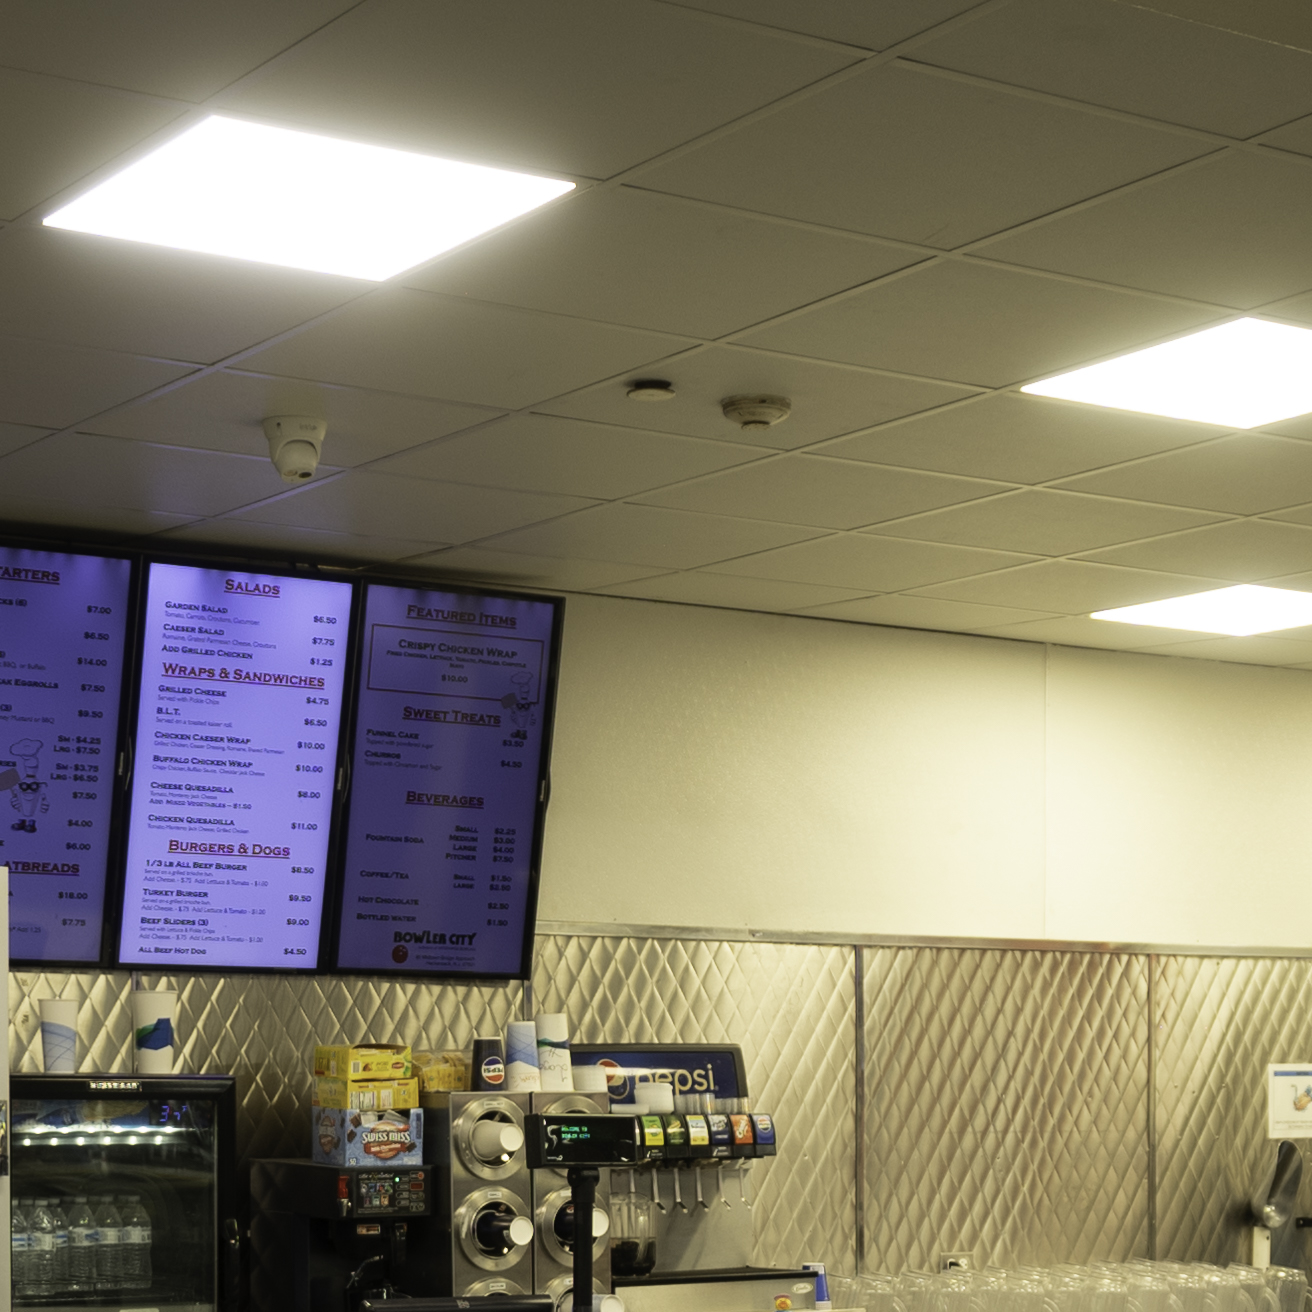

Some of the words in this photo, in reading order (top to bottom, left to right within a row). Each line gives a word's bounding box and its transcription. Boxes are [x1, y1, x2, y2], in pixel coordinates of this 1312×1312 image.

[225, 578, 280, 595] SALADS
[407, 604, 476, 622] FEATURED
[479, 612, 516, 626] ITEMS
[162, 662, 215, 678] WRAPS
[219, 667, 230, 680] &
[233, 669, 325, 687] SANDWICHES
[168, 839, 235, 854] BURGERS
[237, 843, 249, 855] &
[252, 844, 291, 857] DOGS
[393, 930, 447, 945] BOWLER
[449, 932, 477, 946] CITY
[362, 1130, 388, 1144] SWISS
[389, 1130, 411, 1142] MISS
